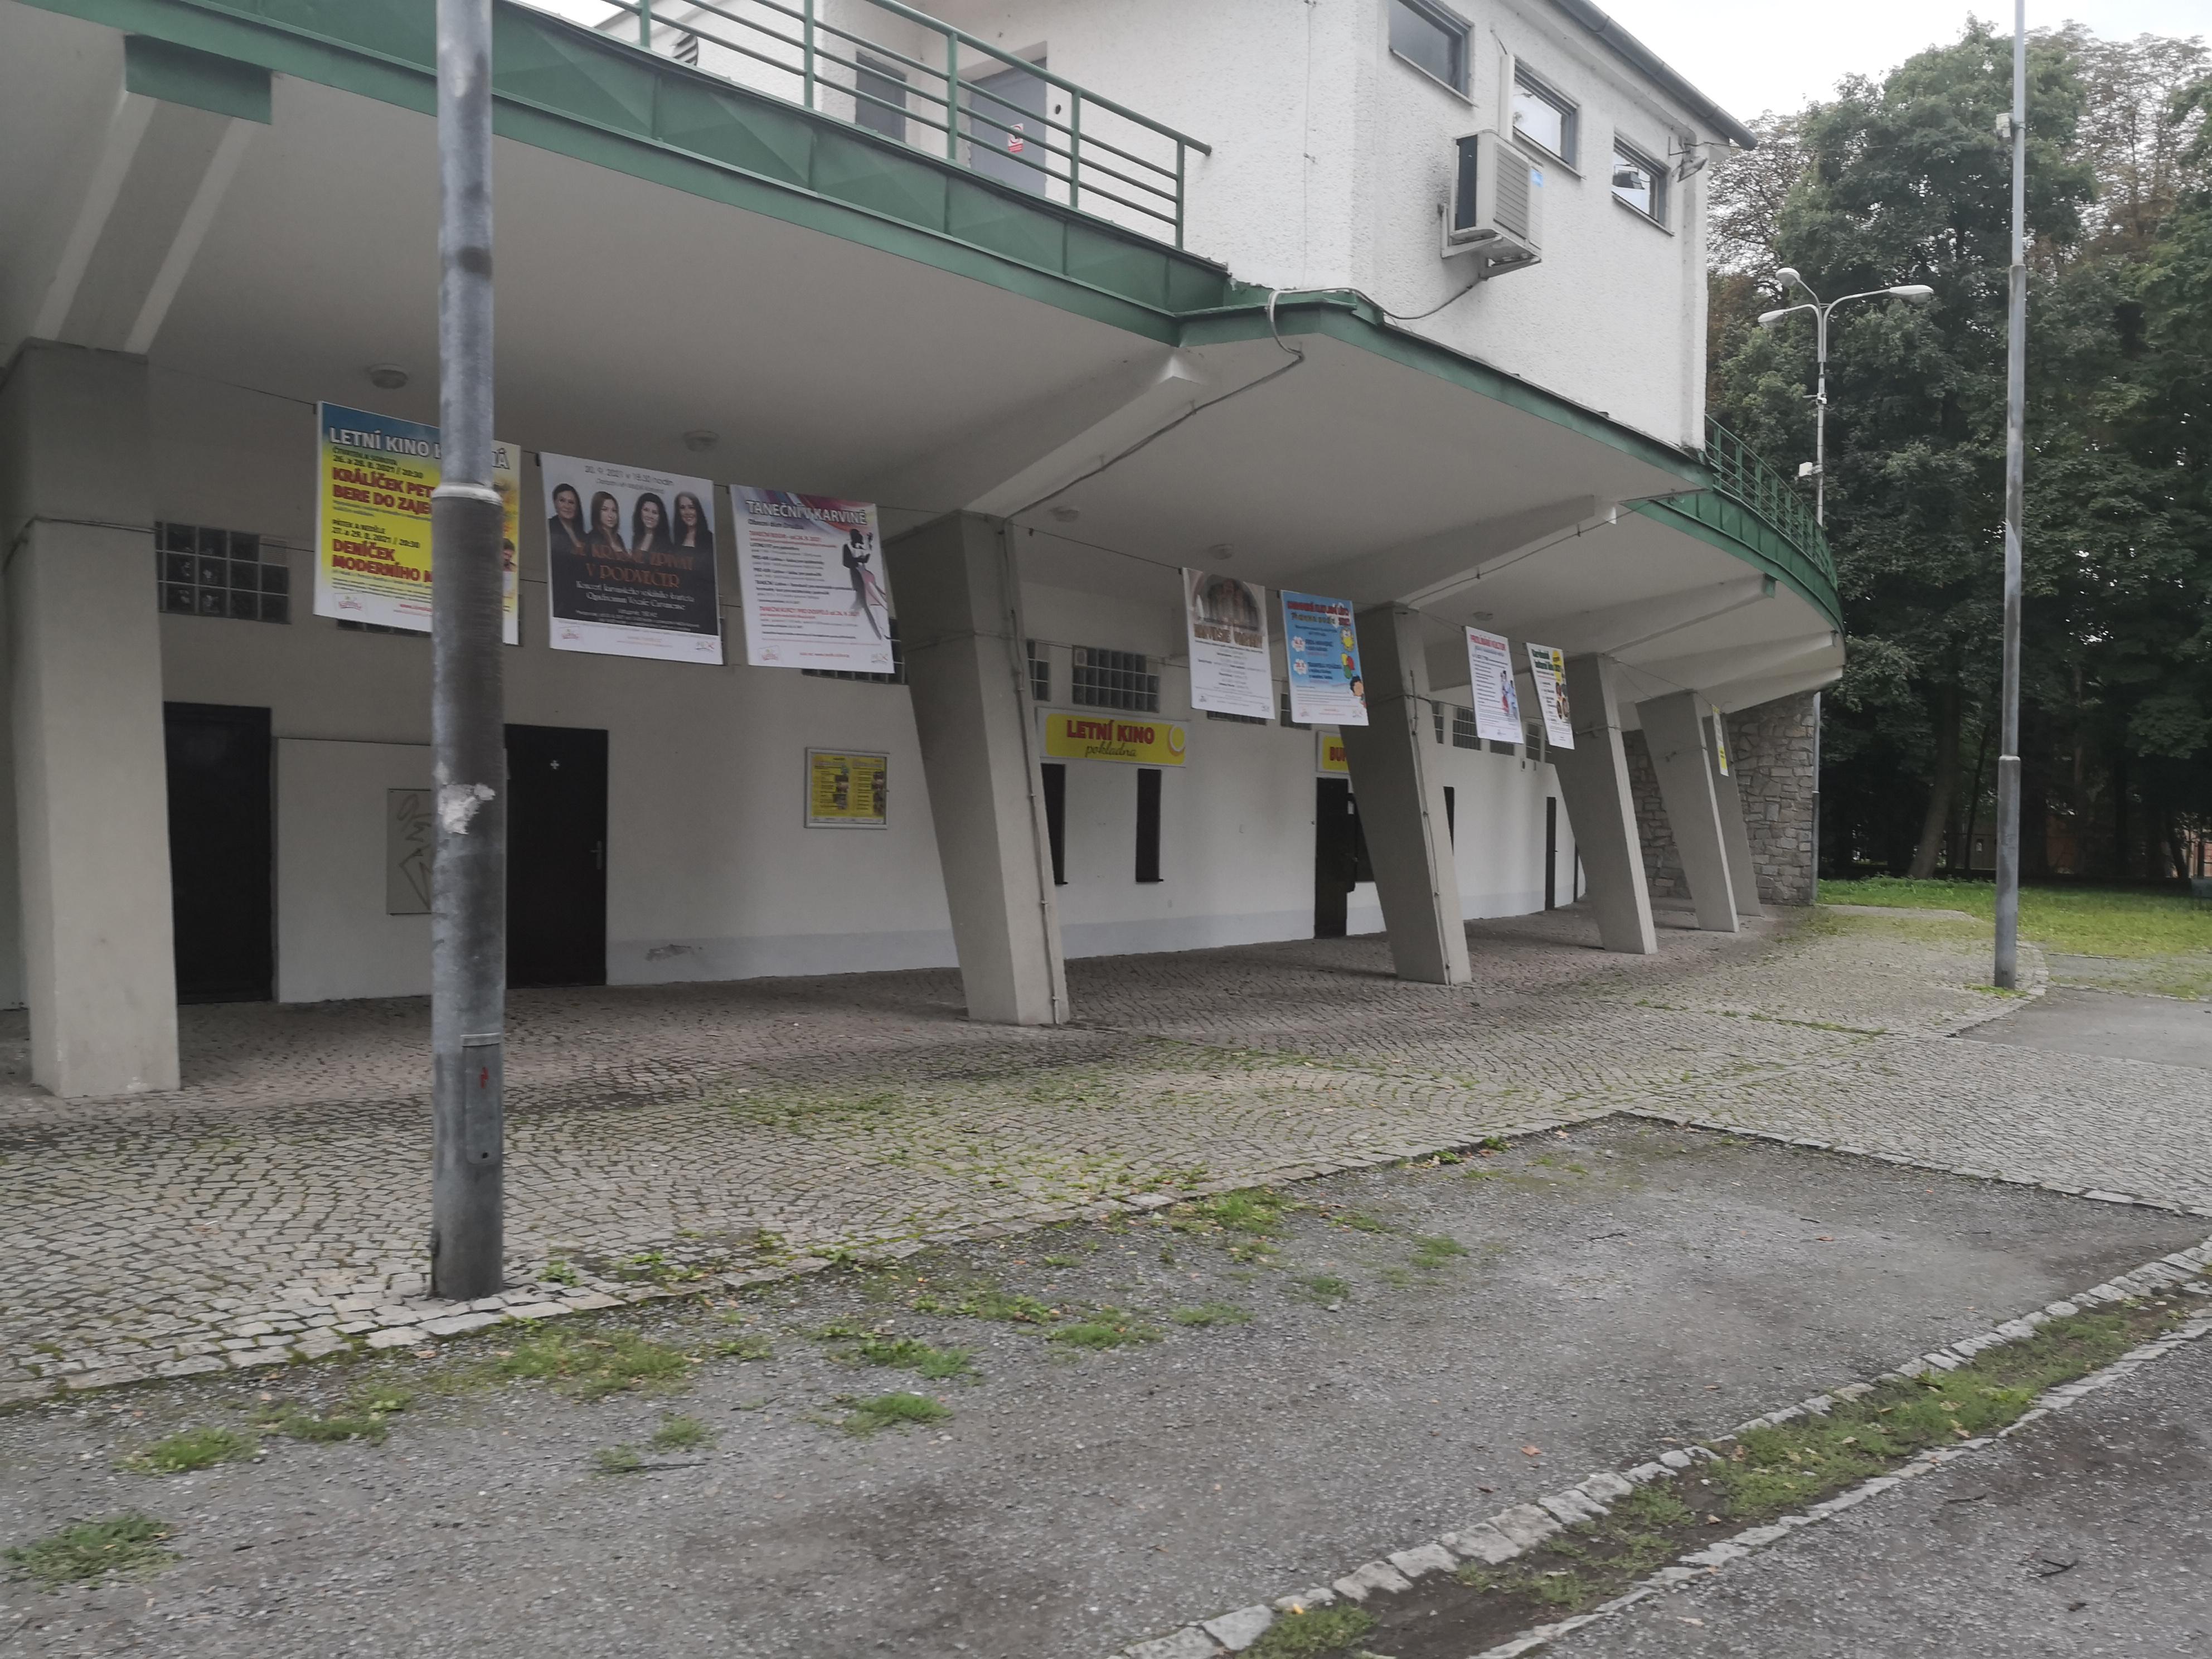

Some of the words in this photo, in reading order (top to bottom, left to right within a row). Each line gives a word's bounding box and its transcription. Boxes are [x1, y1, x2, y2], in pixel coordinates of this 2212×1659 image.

[329, 426, 381, 450] LETNÍ
[385, 434, 429, 458] KINO
[333, 467, 404, 493] KRÁLÍČEK
[333, 484, 370, 503] BERE
[373, 492, 395, 508] DO
[333, 538, 395, 562] DENÍČEK
[332, 554, 421, 581] MODERNÍHO
[1066, 719, 1114, 741] LETNÍ
[1117, 725, 1155, 744] KINO
[1085, 741, 1137, 758] pokladna
